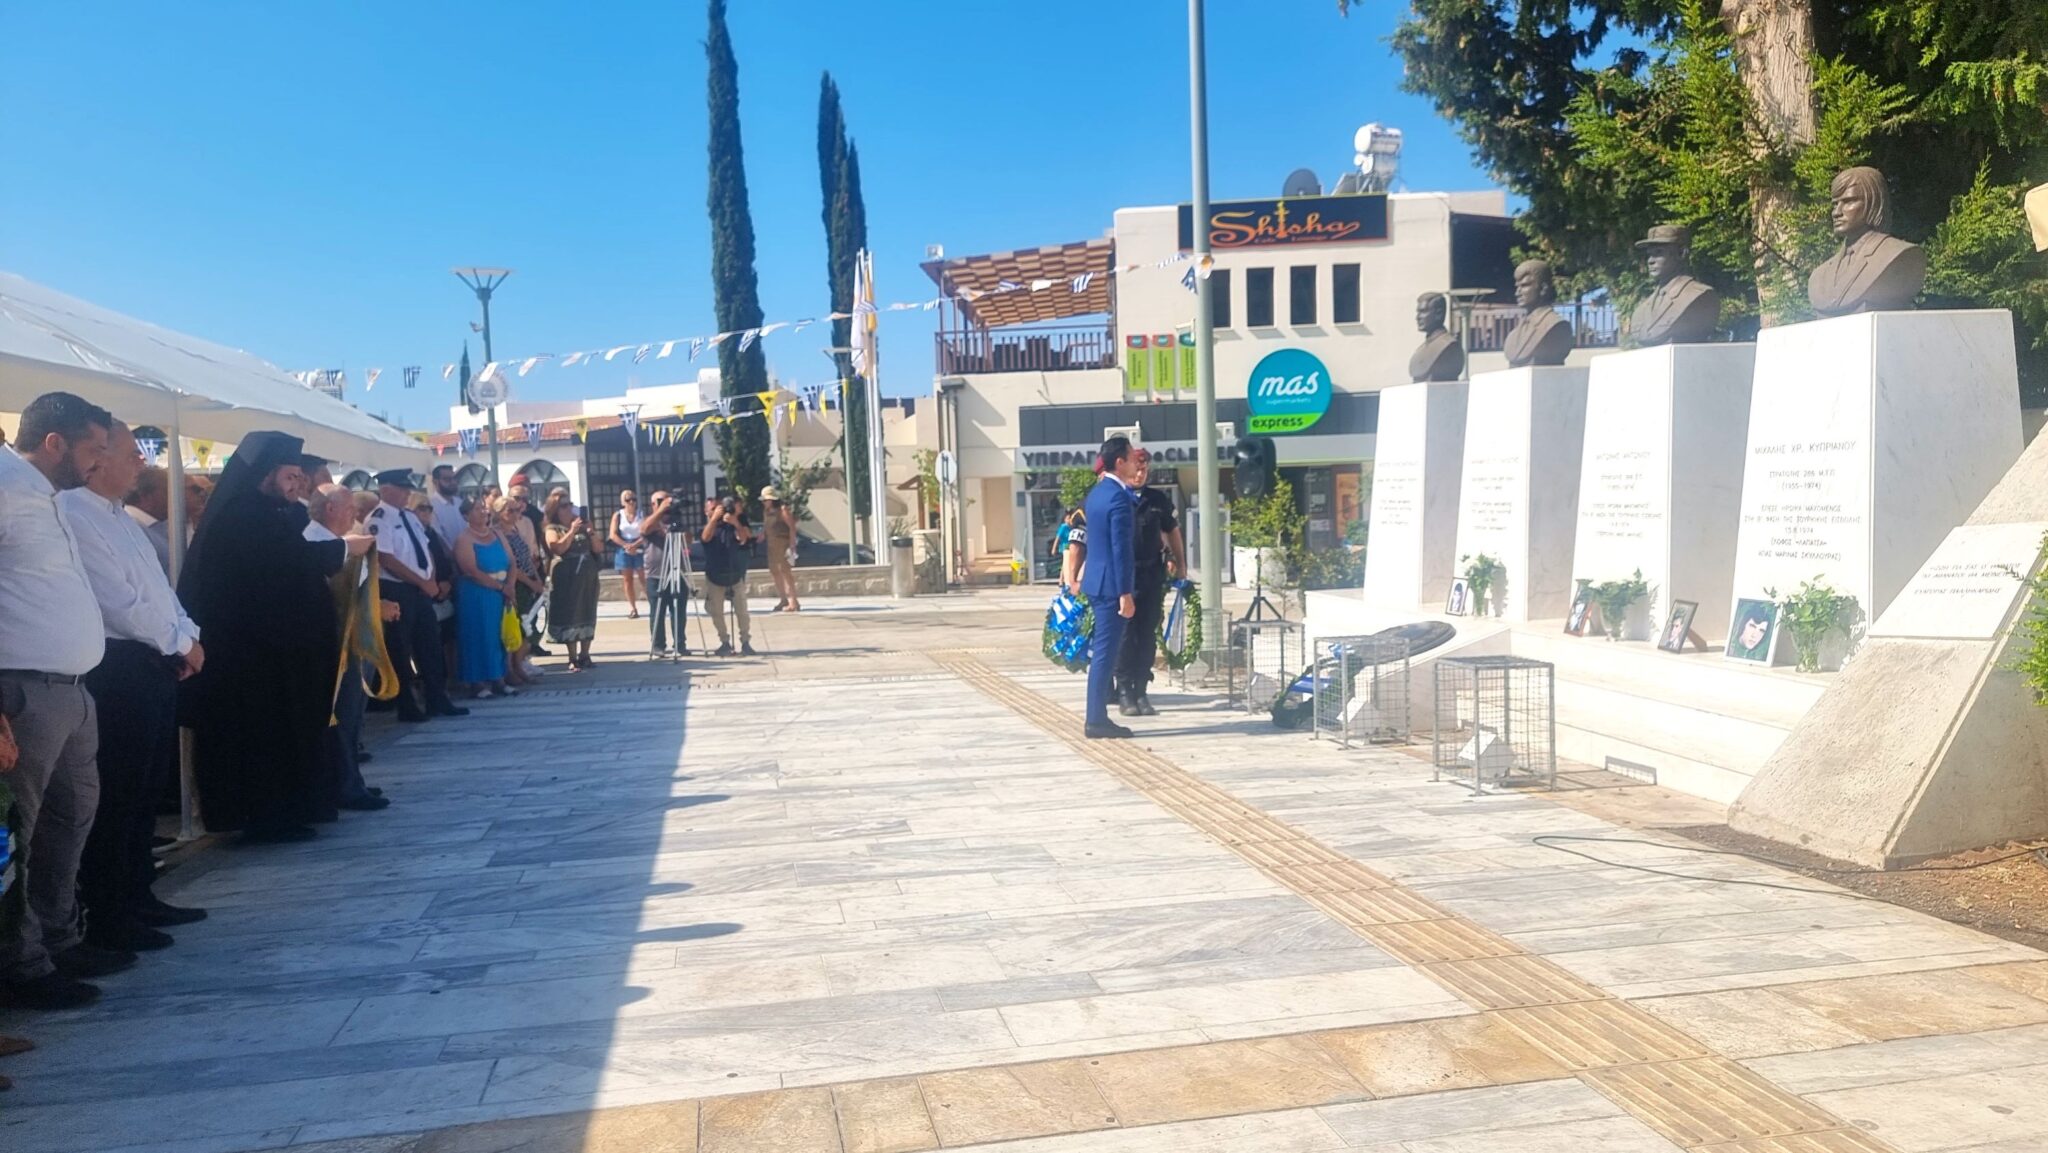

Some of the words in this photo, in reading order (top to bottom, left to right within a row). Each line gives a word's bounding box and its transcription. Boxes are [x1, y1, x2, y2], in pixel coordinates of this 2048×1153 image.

[1209, 200, 1361, 247] Shisha
[1258, 371, 1319, 397] mas
[1252, 417, 1303, 429] express
[1755, 445, 1786, 455] ΜΙΧΑΛΗΣ
[1791, 443, 1804, 453] ΧΡ.
[1809, 440, 1857, 453] ΚΥΠΡΙΑΝΟΥ
